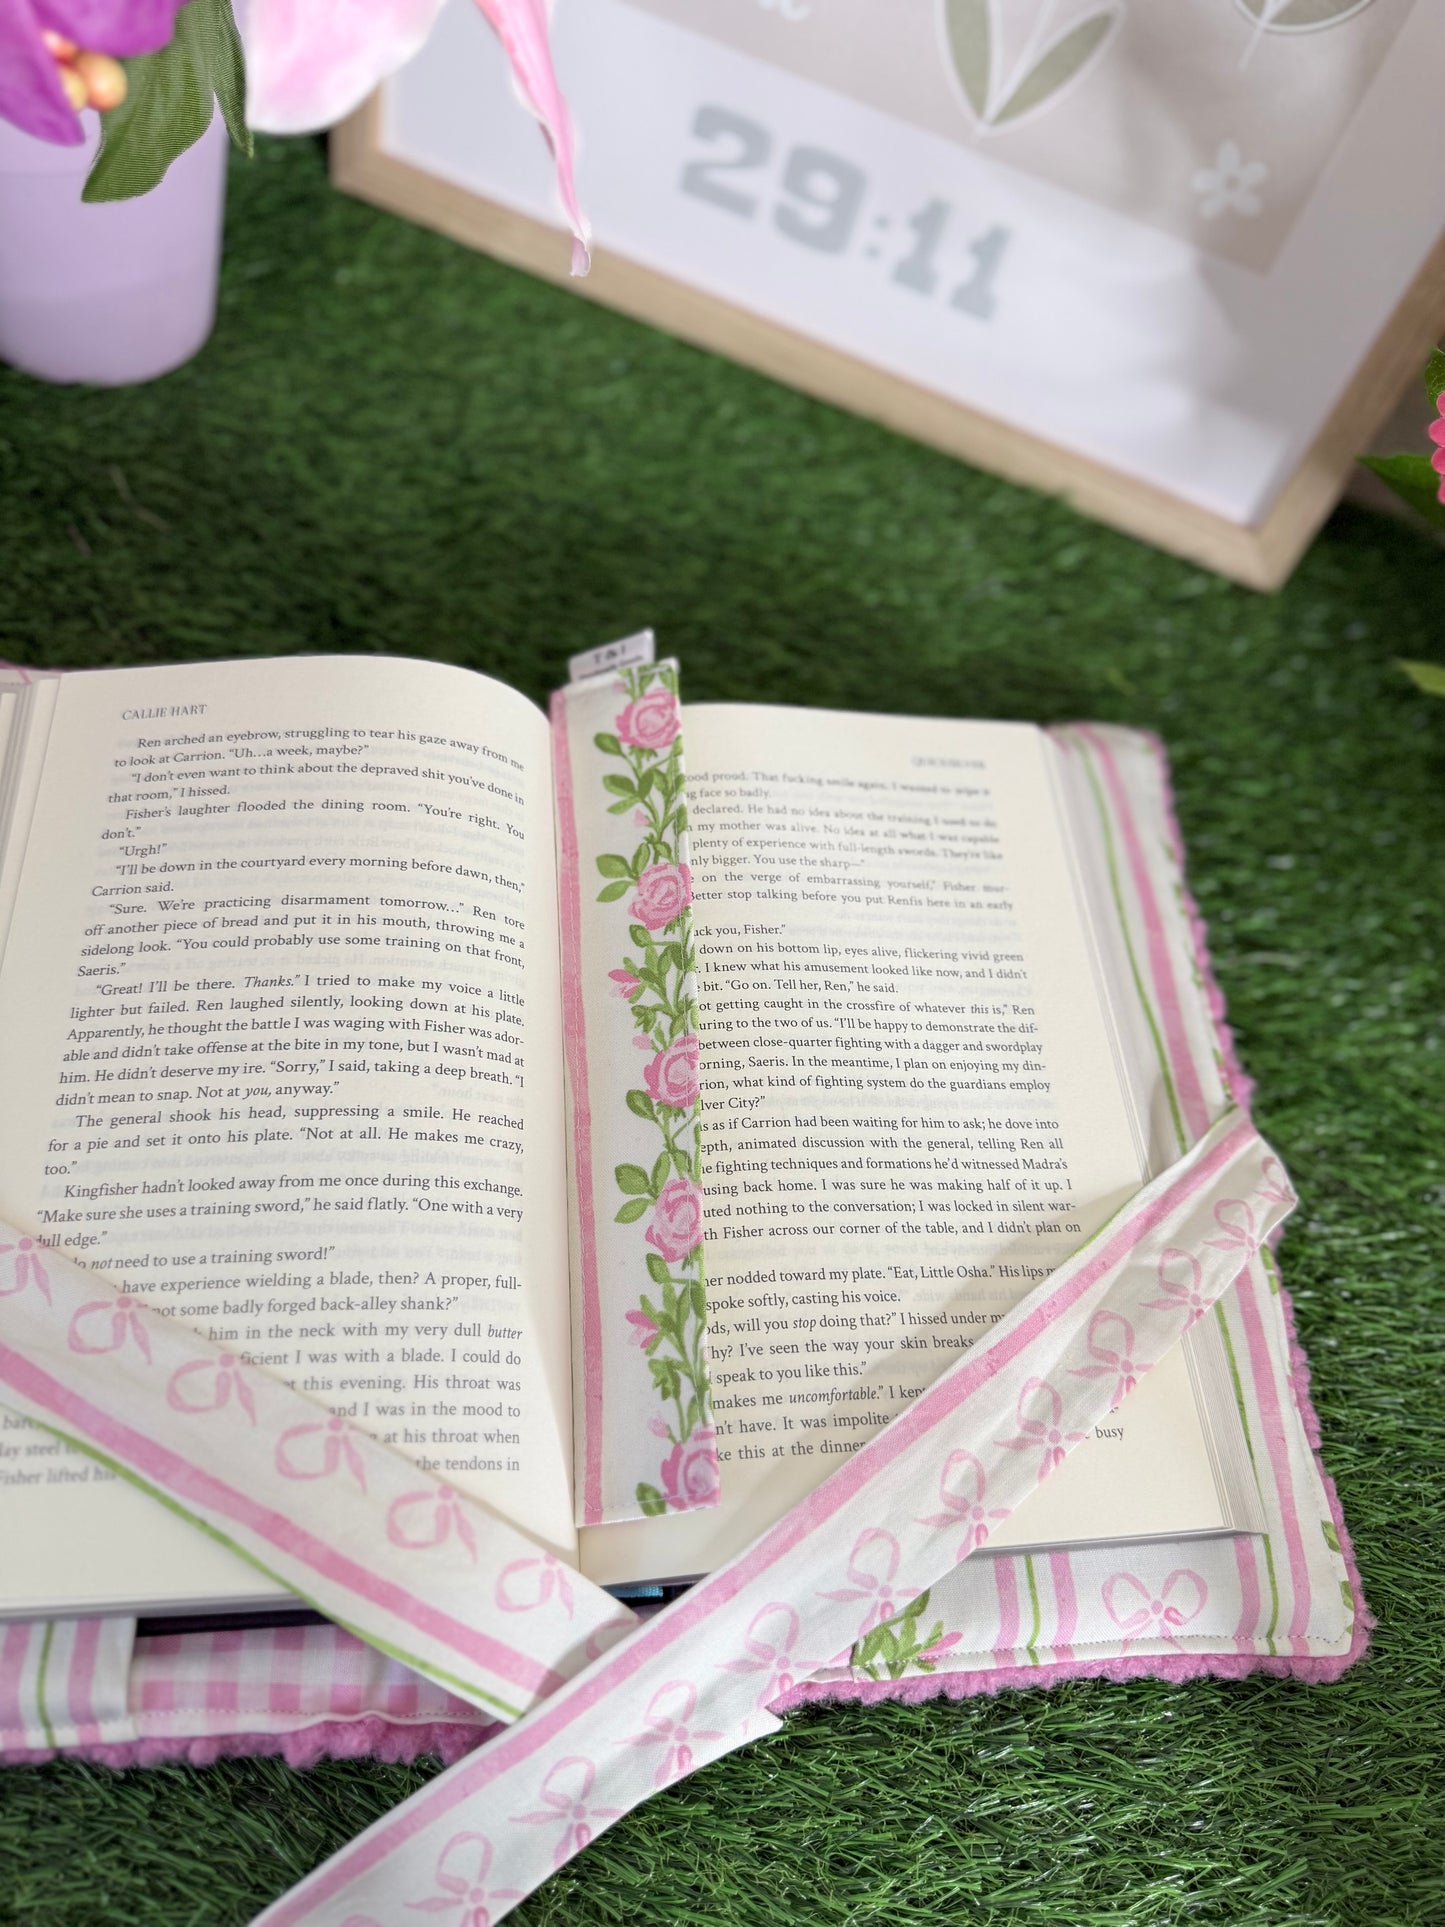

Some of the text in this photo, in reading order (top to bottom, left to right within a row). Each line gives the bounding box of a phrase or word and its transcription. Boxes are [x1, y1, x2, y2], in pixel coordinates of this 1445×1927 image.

[681, 104, 1011, 321] 29:11
[121, 703, 208, 721] CALLIE HART
[137, 727, 525, 772] Ren arched an eyebrow, struggling to tear his gaze away from me
[140, 863, 157, 875] be
[158, 862, 196, 873] down
[199, 860, 213, 871] in
[216, 858, 238, 870] the
[240, 855, 306, 870] courtyard
[308, 857, 347, 869] every
[349, 856, 408, 872] morning
[411, 858, 453, 874] before
[455, 864, 492, 884] dawn,
[727, 891, 753, 902] stop
[756, 888, 799, 903] talking
[801, 889, 837, 902] before
[840, 895, 862, 905] you
[865, 896, 884, 906] put
[926, 897, 950, 907] here
[954, 900, 966, 908] in
[970, 901, 983, 909] an
[986, 900, 1013, 911] early
[80, 943, 135, 957] sidelong
[138, 940, 171, 953] look.
[212, 935, 250, 949] could
[253, 933, 314, 950] probably
[318, 936, 341, 945] use
[344, 936, 381, 946] some
[385, 936, 441, 953] training
[445, 943, 462, 953] on
[466, 943, 491, 958] that
[494, 949, 525, 970] front,
[699, 941, 1024, 964] down on his bottom lip, eyes alive, flickering vivid green
[69, 994, 525, 1027] lighter but failed. Ren laughed silently, looking down at his plate.
[715, 998, 760, 1013] getting
[763, 997, 804, 1012] caught
[807, 998, 820, 1009] in
[823, 998, 843, 1010] the
[846, 999, 896, 1012] crossfire
[898, 1001, 912, 1012] of
[913, 1001, 966, 1014] whatever
[970, 1003, 989, 1015] this
[1011, 1004, 1036, 1015] Ren
[732, 1074, 1051, 1093] what kind of fighting system do the guardians employ
[75, 1104, 524, 1131] The general shook his head, suppressing a smile. He reached
[737, 1136, 1064, 1153] animated discussion with the general, telling Ren all
[64, 1182, 139, 1201] Kingfisher
[187, 1176, 236, 1192] looked
[238, 1179, 276, 1192] away
[278, 1174, 315, 1188] from
[318, 1177, 342, 1187] me
[344, 1177, 379, 1187] once
[382, 1173, 431, 1191] during
[434, 1175, 460, 1189] this
[463, 1178, 523, 1199] exchange.
[735, 1199, 1076, 1217] nothing to the conversation; I was locked in silent war-
[208, 1321, 523, 1341] him in the neck with my very dull butter
[769, 1343, 800, 1355] seen
[804, 1339, 827, 1353] the
[832, 1341, 859, 1355] way
[863, 1340, 895, 1354] your
[900, 1335, 928, 1350] skin
[931, 1334, 975, 1349] breaks
[1094, 1425, 1124, 1441] busy
